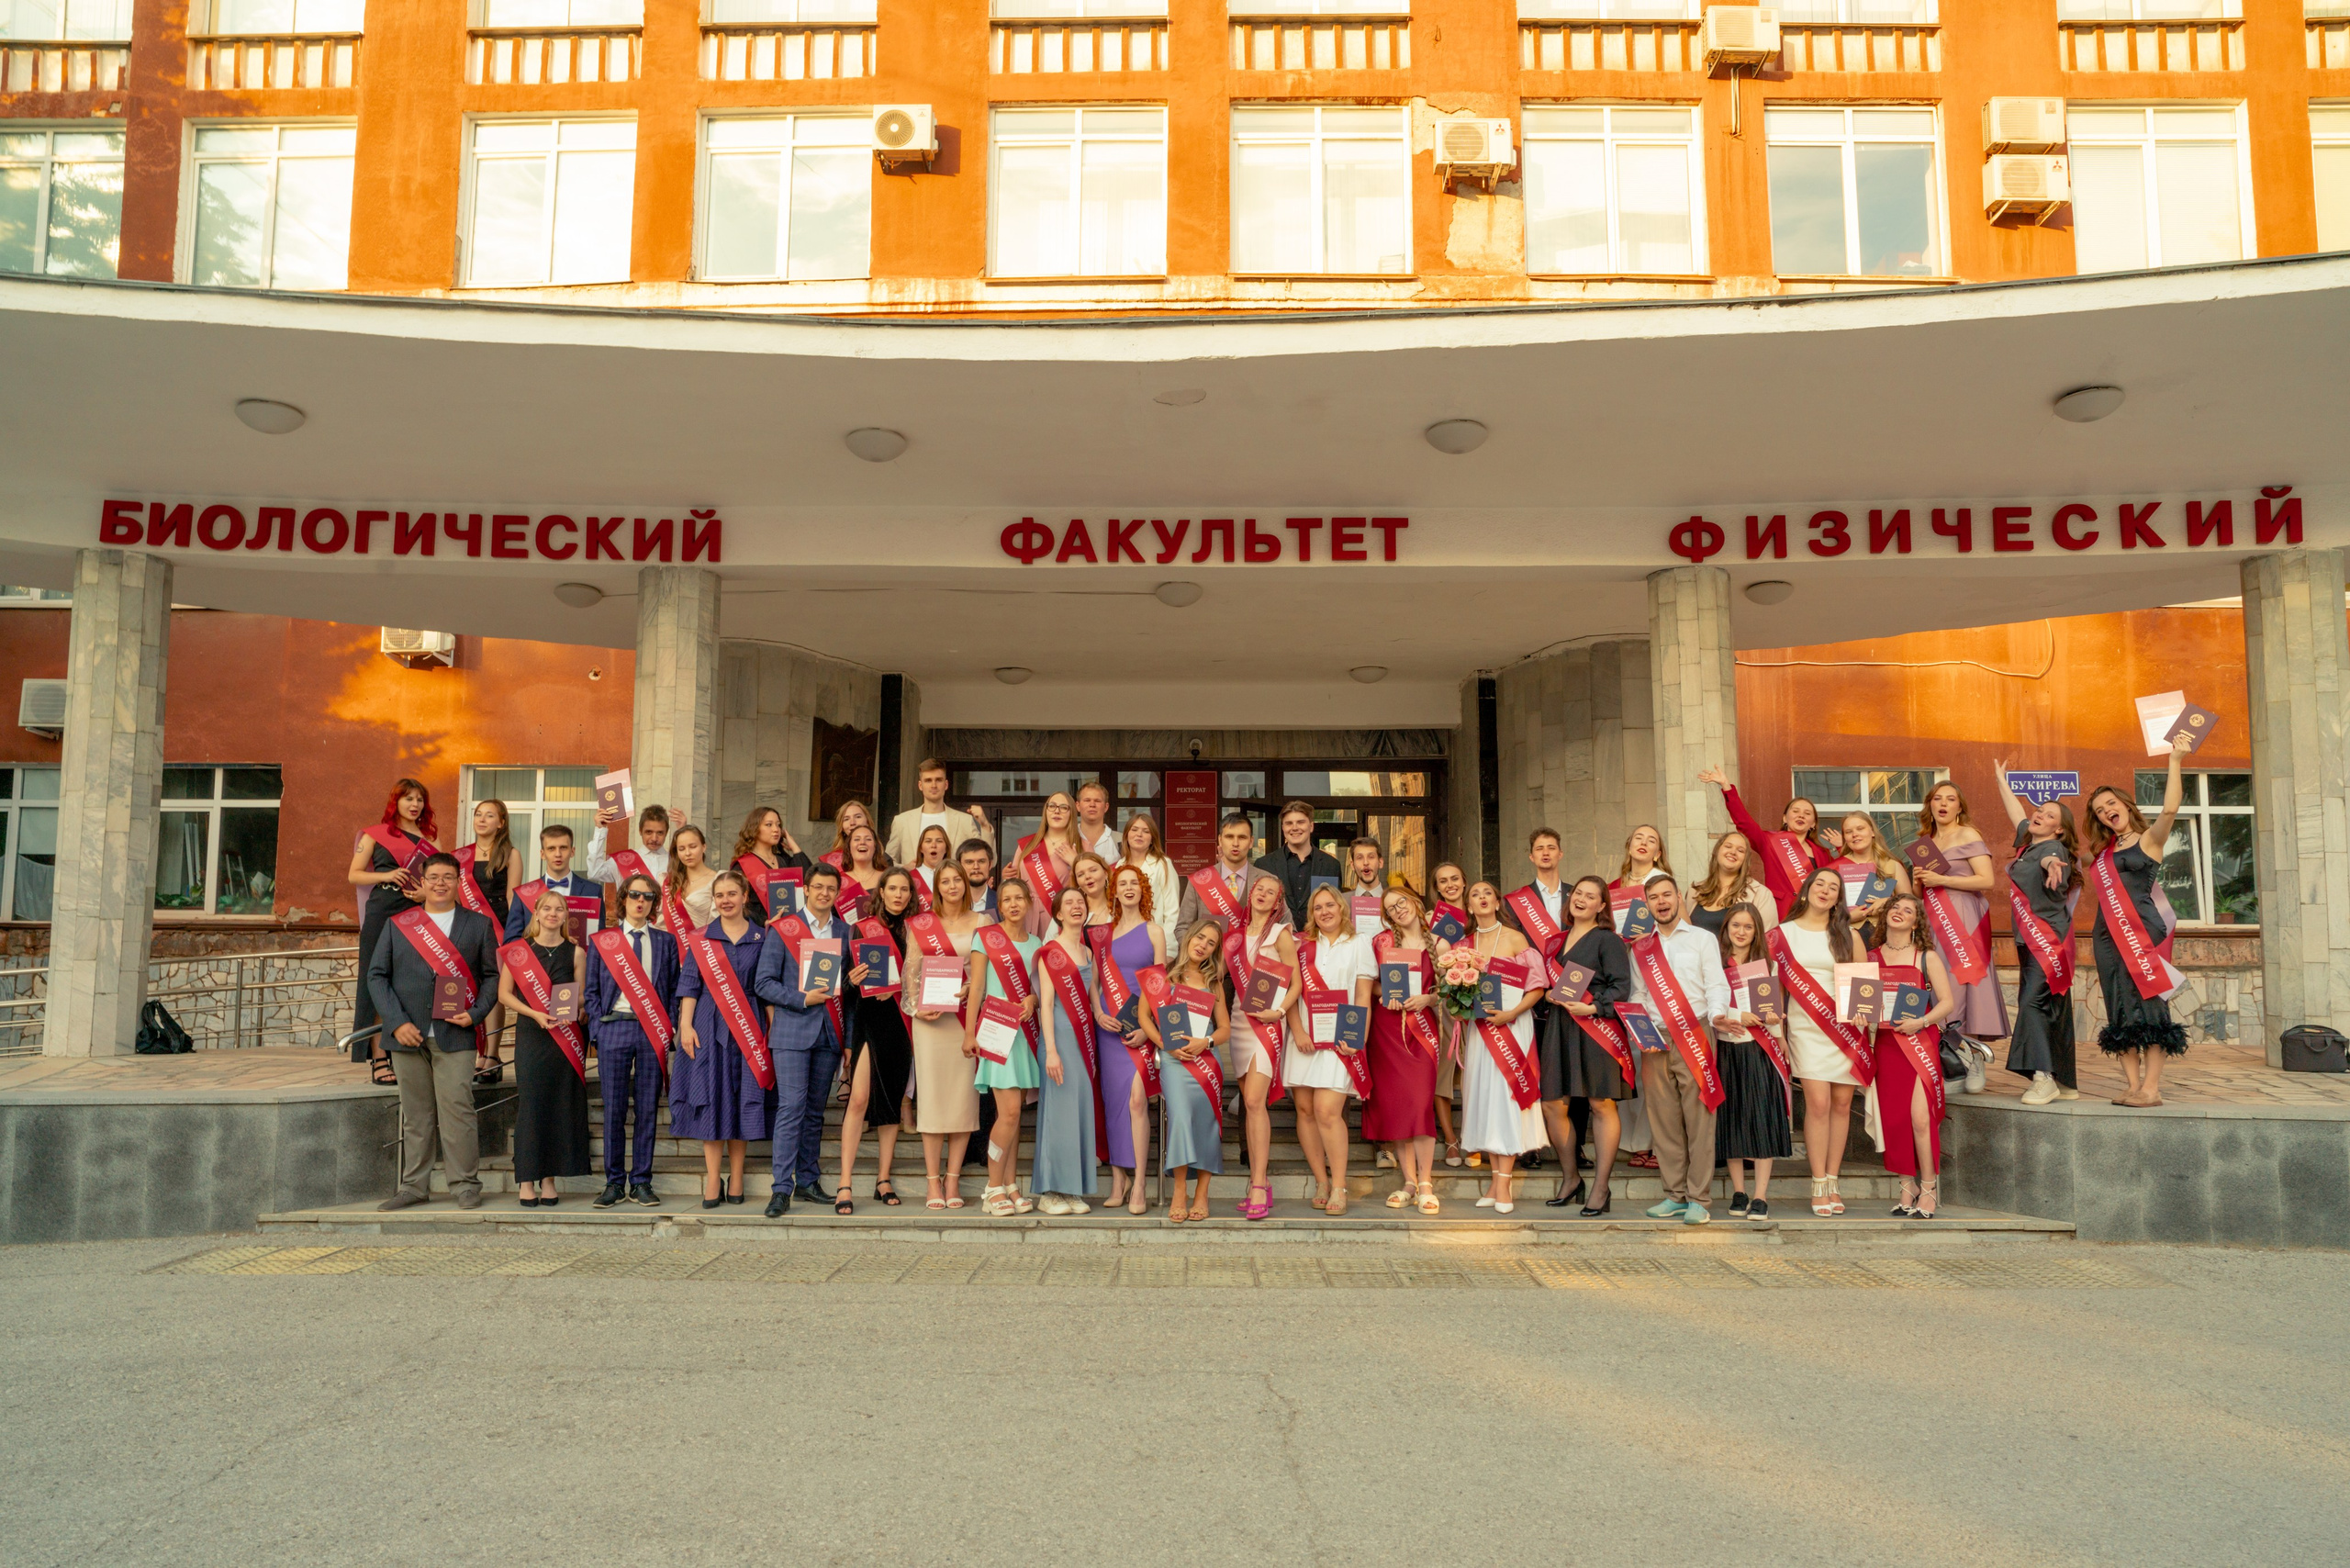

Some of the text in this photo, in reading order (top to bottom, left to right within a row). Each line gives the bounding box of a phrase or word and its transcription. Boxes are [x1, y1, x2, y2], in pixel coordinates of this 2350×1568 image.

[99, 499, 723, 563] БИОЛОГИЧЕСКИЙ
[1001, 517, 1409, 565] ФАКУЛЬТЕТ
[1668, 487, 2303, 564] ФИЗИЧЕСКИЙ
[2010, 780, 2076, 790] БУКИРЕВА
[2037, 791, 2051, 802] 15
[1031, 853, 1053, 891] ЛУЧШИЙ
[1780, 838, 1803, 878] ЛУЧШИЙ
[1208, 887, 1241, 929] ЛУЧШИЙ
[1518, 896, 1550, 940] ЛУЧШИЙ
[1926, 888, 1972, 969] ВЫПУСКНИК 2024
[414, 924, 450, 964] ЛУЧШИЙ
[2013, 897, 2063, 978] ВЫПУСКНИК 2024
[2106, 888, 2146, 958] ВЫПУСКНИК
[2137, 957, 2156, 981] 2024
[615, 953, 646, 999] ЛУЧШИЙ
[1102, 946, 1121, 993] ЛУЧШИЙ
[700, 939, 768, 1071] ЛУЧШИЙ ВЫПУСКНИК 2024
[1062, 975, 1087, 1024] ЛУЧШИЙ
[1776, 951, 1809, 995] ЛУЧШИЙ
[1807, 991, 1859, 1051] ВЫПУСКНИК
[1857, 1047, 1872, 1070] 2024
[1646, 953, 1717, 1094] ЛУЧШИЙ ВЫПУСКНИК 2024
[1144, 1057, 1157, 1081] 2024
[1352, 1058, 1367, 1082] 2024
[1515, 1070, 1530, 1094] 2024
